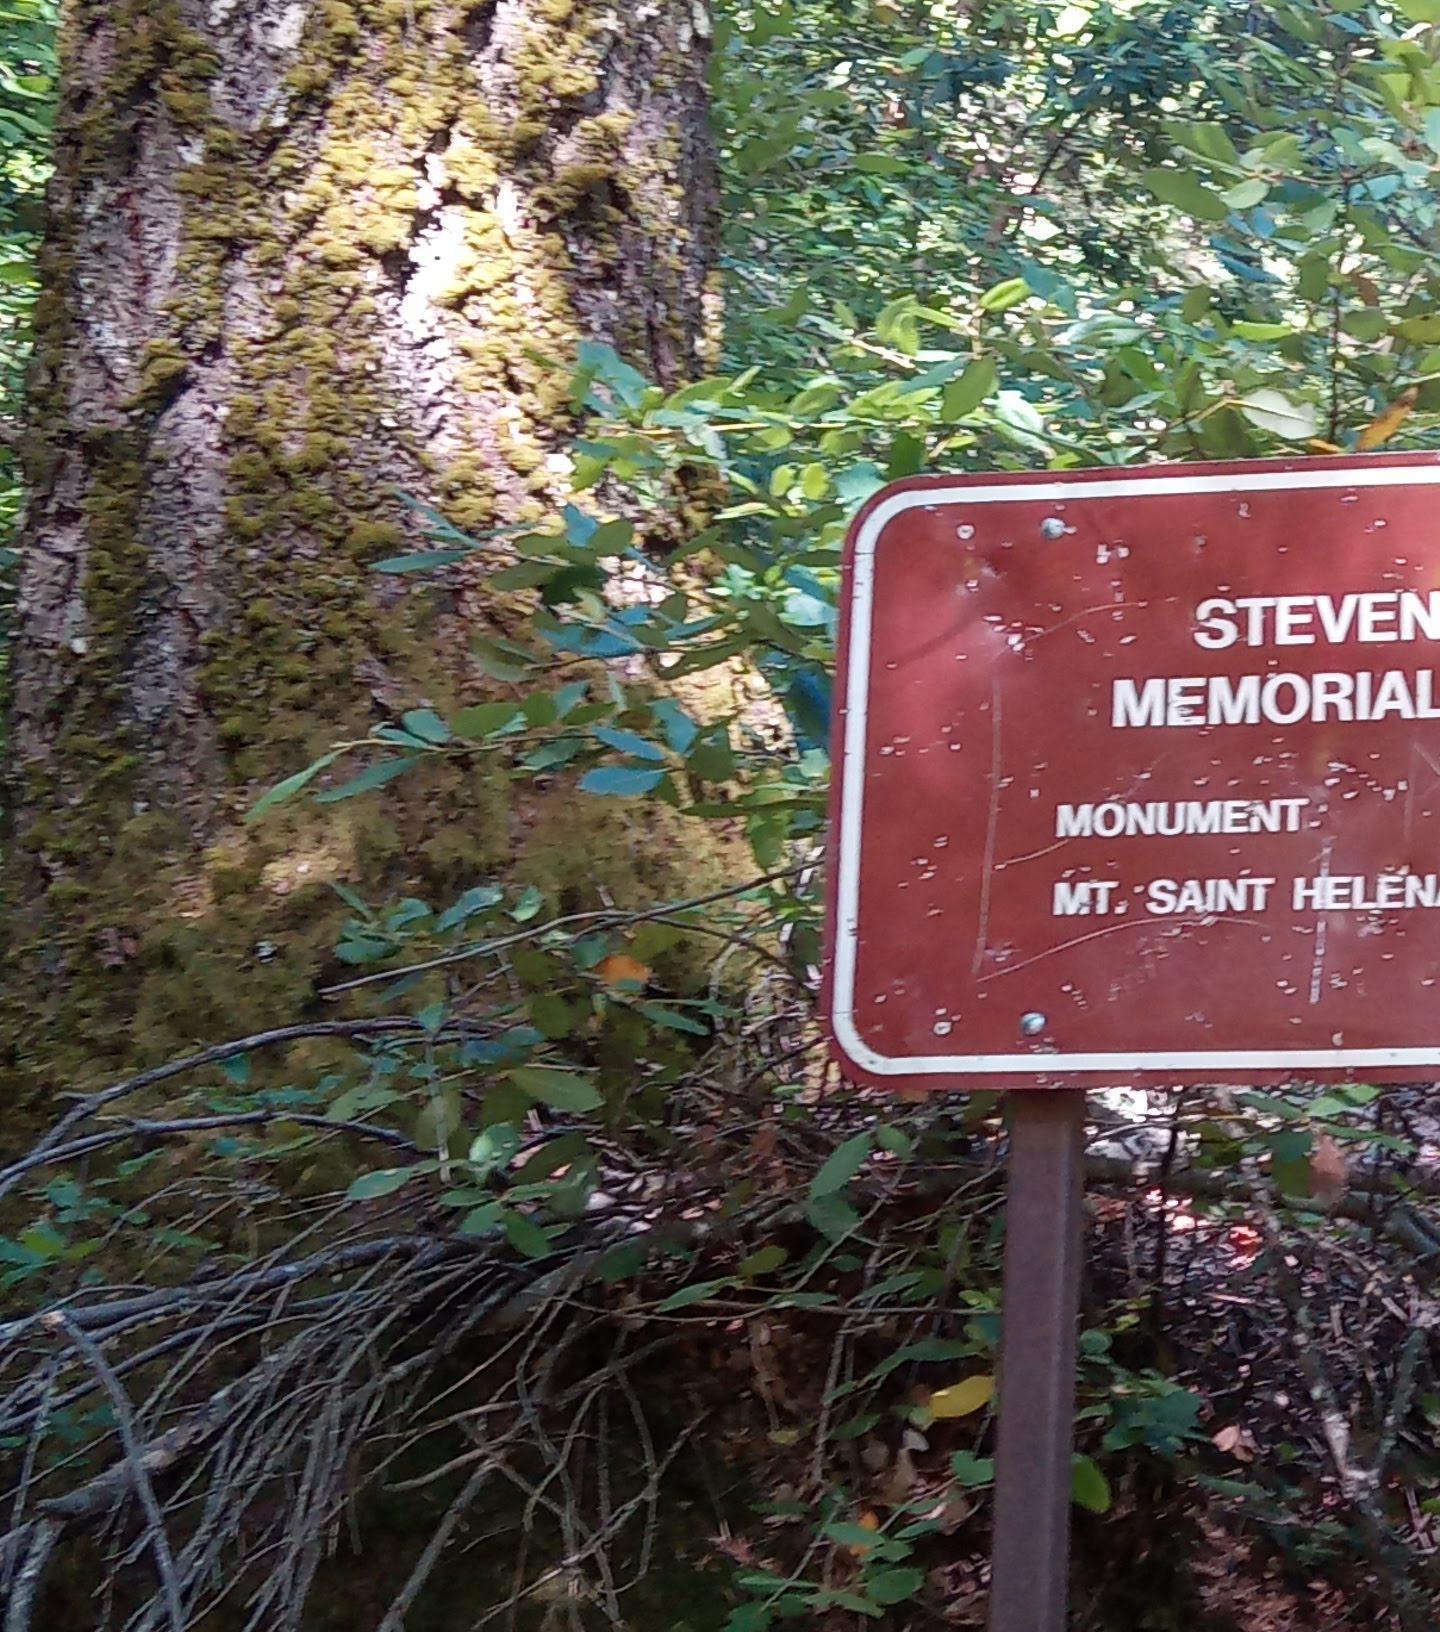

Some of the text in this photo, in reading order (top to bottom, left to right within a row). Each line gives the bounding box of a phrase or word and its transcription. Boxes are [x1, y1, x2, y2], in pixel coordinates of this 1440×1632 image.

[1055, 797, 1309, 838] MONUMENT
[1053, 881, 1127, 916] MT.
[1145, 877, 1275, 915] SAINT
